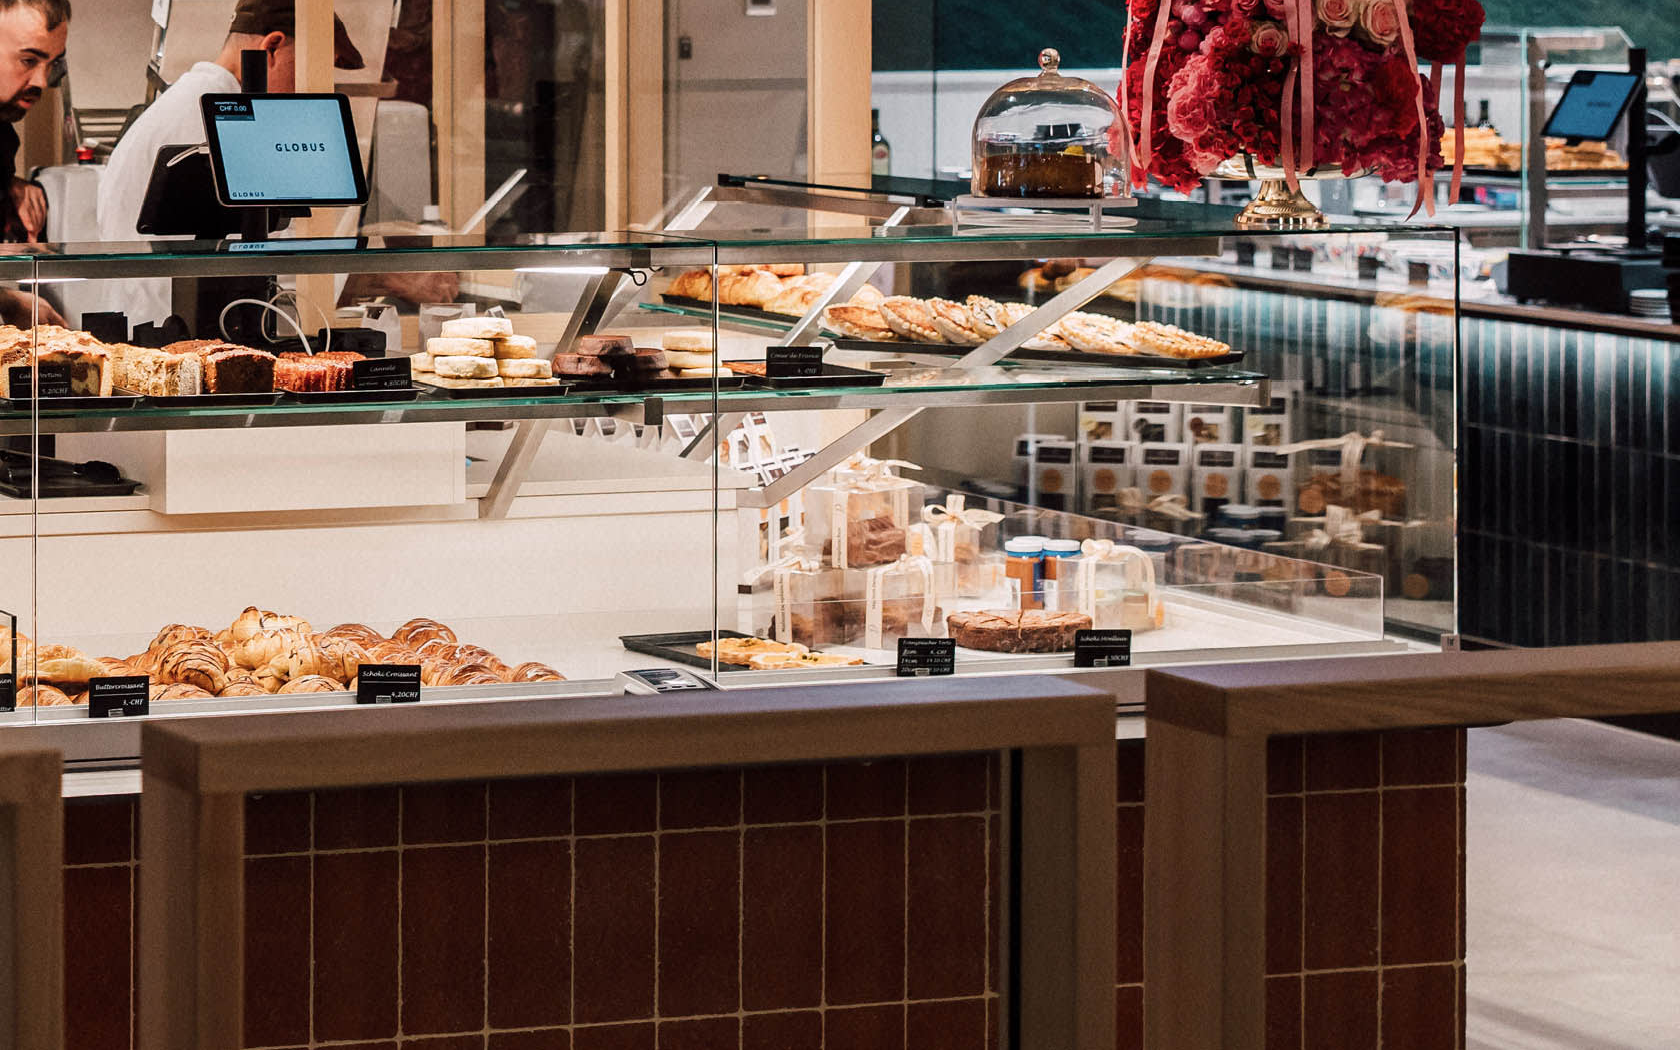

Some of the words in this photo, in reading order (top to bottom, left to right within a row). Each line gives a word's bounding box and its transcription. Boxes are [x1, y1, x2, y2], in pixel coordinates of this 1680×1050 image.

[275, 142, 326, 152] GLOBUS
[385, 670, 419, 678] Croissant
[95, 682, 145, 691] Buttercroissant
